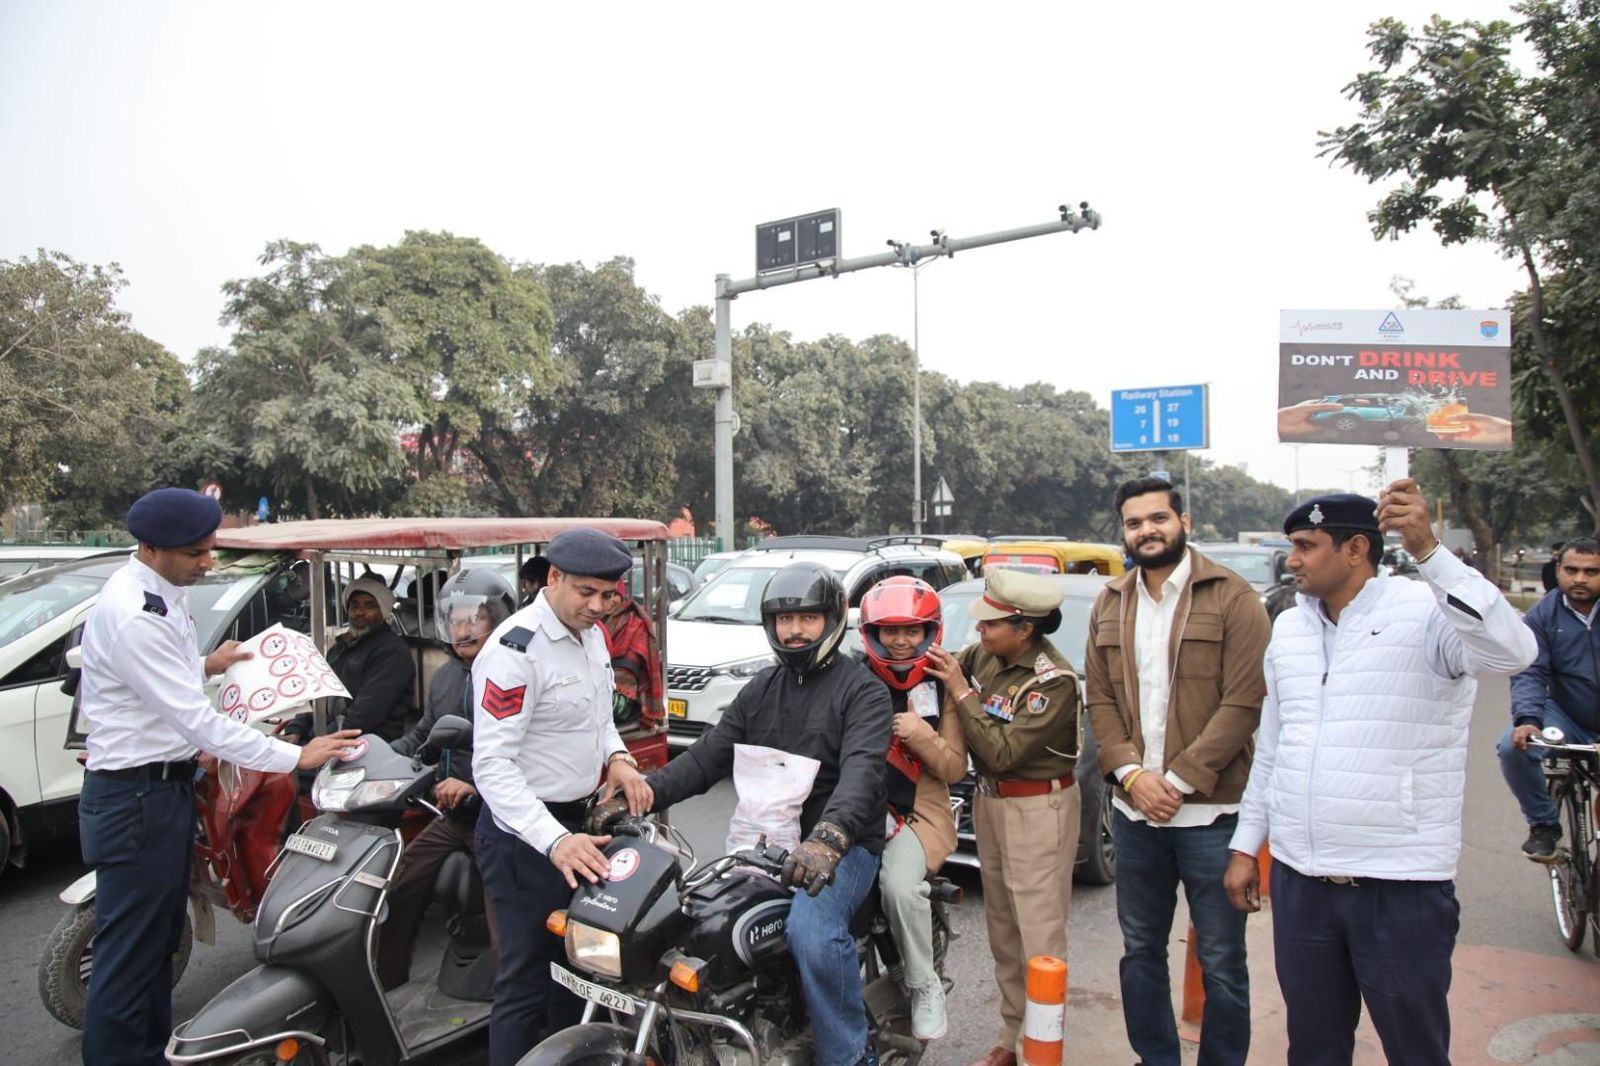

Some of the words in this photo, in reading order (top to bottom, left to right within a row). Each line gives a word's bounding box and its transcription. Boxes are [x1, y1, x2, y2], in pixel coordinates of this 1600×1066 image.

[1291, 354, 1354, 366] DON'T
[1358, 351, 1461, 368] DRINK
[1354, 368, 1399, 380] AND
[1407, 370, 1498, 387] DRIVE
[1121, 391, 1157, 400] Railway
[1158, 388, 1193, 398] Station
[1167, 402, 1179, 412] 27
[761, 918, 782, 938] Hero
